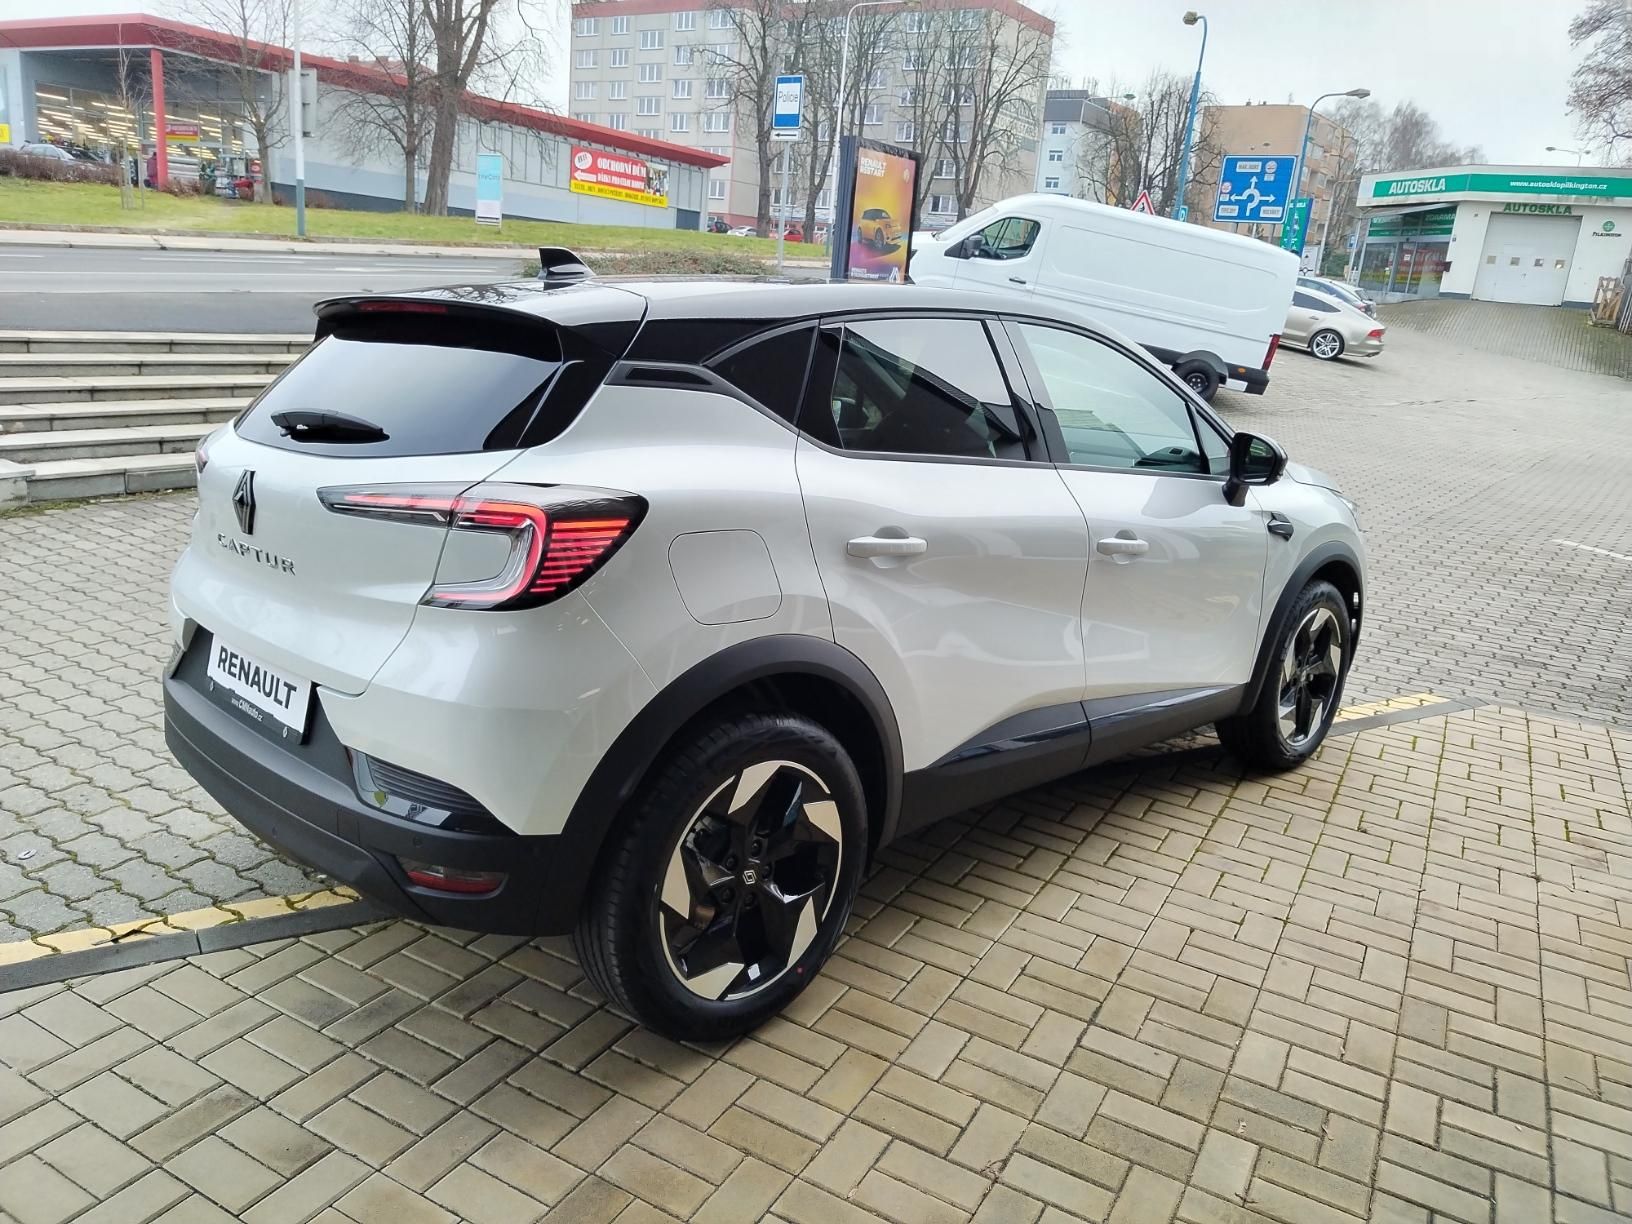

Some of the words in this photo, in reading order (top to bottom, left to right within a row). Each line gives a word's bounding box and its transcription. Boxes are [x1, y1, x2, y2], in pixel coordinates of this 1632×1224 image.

[1388, 178, 1446, 194] AUTOSKLA
[1509, 180, 1608, 190] www.autosklopilkington.cz
[1503, 202, 1573, 215] AUTOSKLA
[217, 532, 296, 576] CAPTUR
[217, 645, 297, 710] RENAULT
